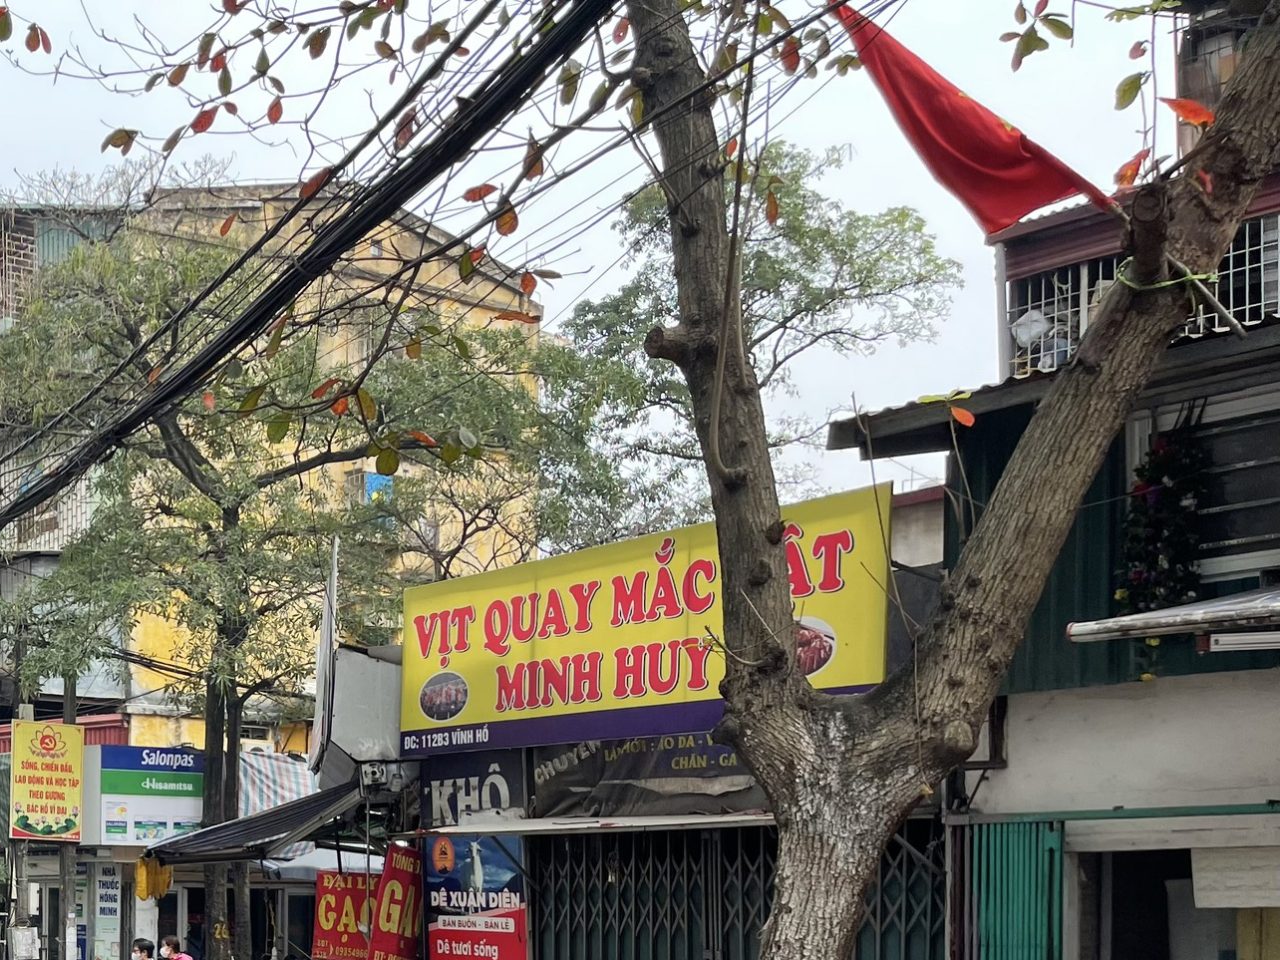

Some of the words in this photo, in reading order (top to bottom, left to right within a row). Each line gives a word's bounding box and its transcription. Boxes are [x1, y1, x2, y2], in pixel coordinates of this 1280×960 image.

[413, 604, 474, 668] VỊT
[483, 580, 602, 658] QUAY
[610, 537, 716, 627] MẮC
[495, 649, 603, 715] MINH
[613, 636, 714, 699] HUY
[404, 735, 419, 750] ĐC:
[421, 732, 449, 748] 112B3
[451, 728, 474, 745] VĨNH
[475, 723, 489, 743] HỒ
[140, 749, 195, 769] Salonpas
[29, 790, 43, 799] THEO
[430, 762, 510, 827] KHÔ
[430, 887, 447, 907] DÊ
[100, 906, 118, 917] MINH
[437, 938, 449, 954] Dê
[474, 939, 499, 960] sống
